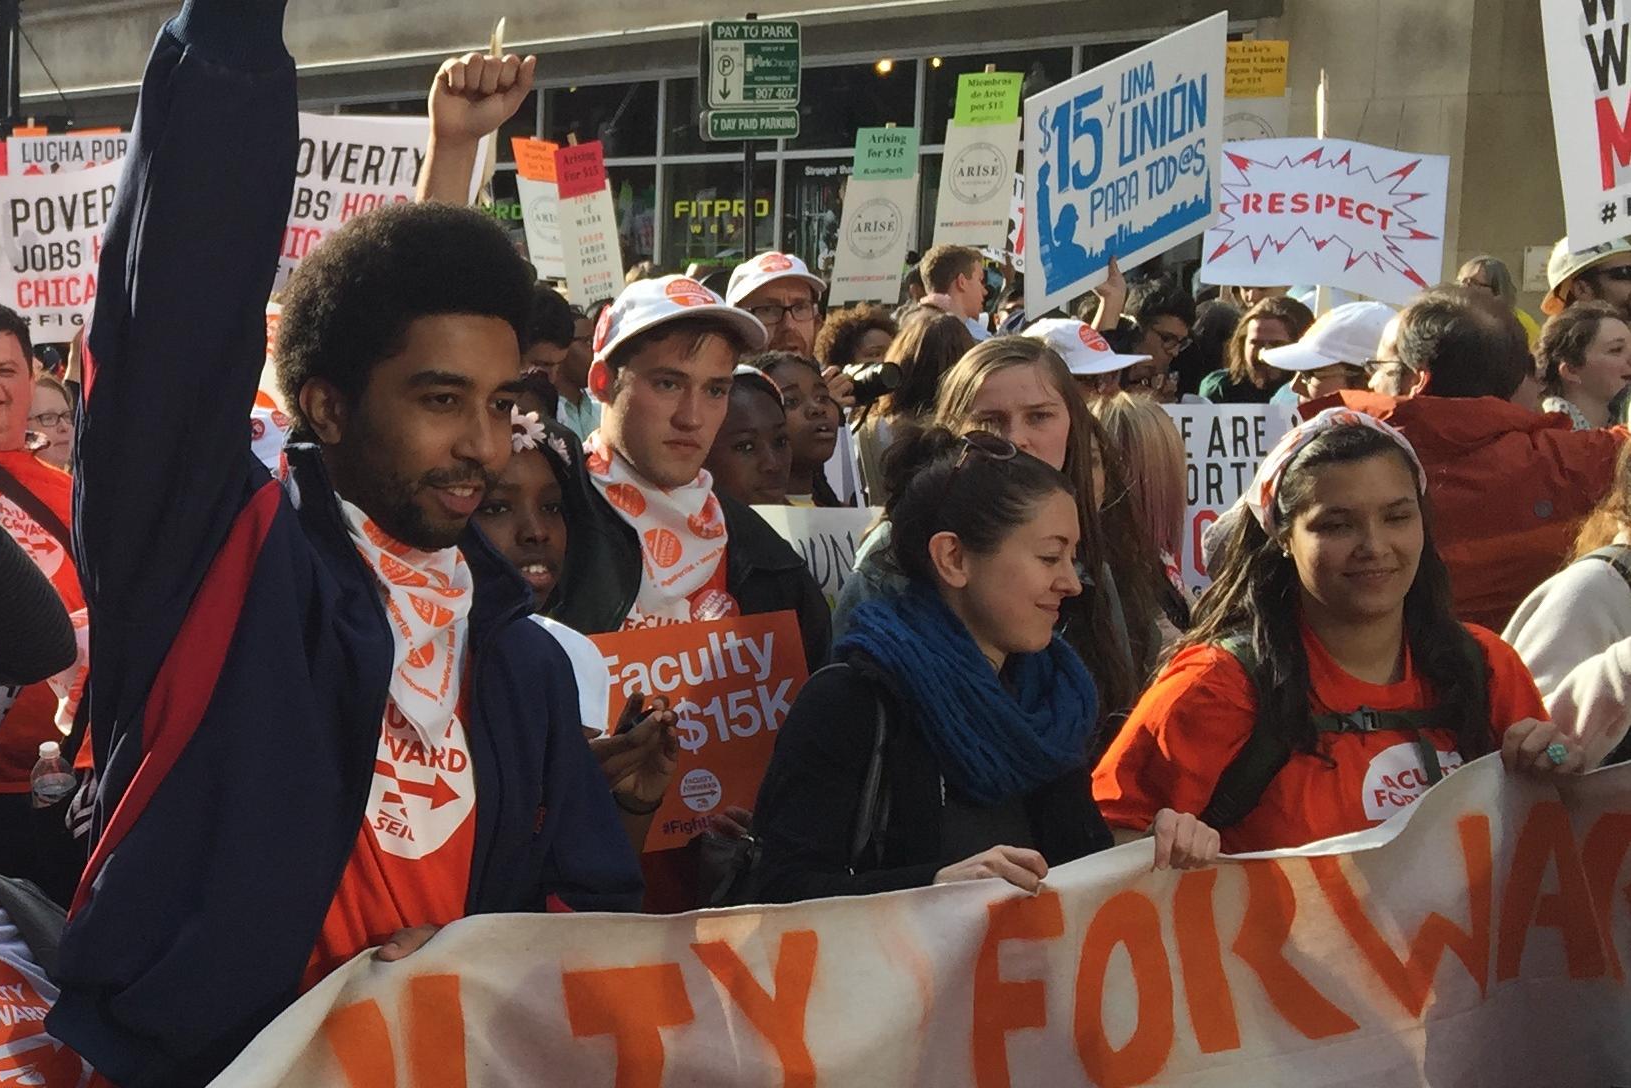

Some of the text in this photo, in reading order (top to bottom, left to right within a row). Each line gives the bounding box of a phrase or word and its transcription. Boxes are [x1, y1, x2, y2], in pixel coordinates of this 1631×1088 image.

[716, 25, 794, 39] PAY TO PARK
[755, 88, 773, 99] 907
[967, 77, 1012, 88] Miembros
[1120, 60, 1156, 107] UNA
[713, 116, 797, 131] 7 DAY PAID PARKING
[1118, 73, 1208, 168] UNIÓN
[868, 133, 907, 147] Arising
[1038, 85, 1105, 195] $15
[22, 140, 84, 164] LUCHA
[885, 147, 905, 159] $15
[804, 165, 838, 178] Stronger
[956, 164, 1001, 178] ARISE
[1090, 137, 1207, 229] PARA TOD@S
[673, 198, 769, 219] FITPRO
[1242, 192, 1394, 231] RESPECT
[854, 219, 896, 234] ARISE
[13, 239, 82, 274] JOBS
[1207, 415, 1268, 459] ARE
[603, 629, 775, 701] Faculty
[674, 677, 795, 756] $15K
